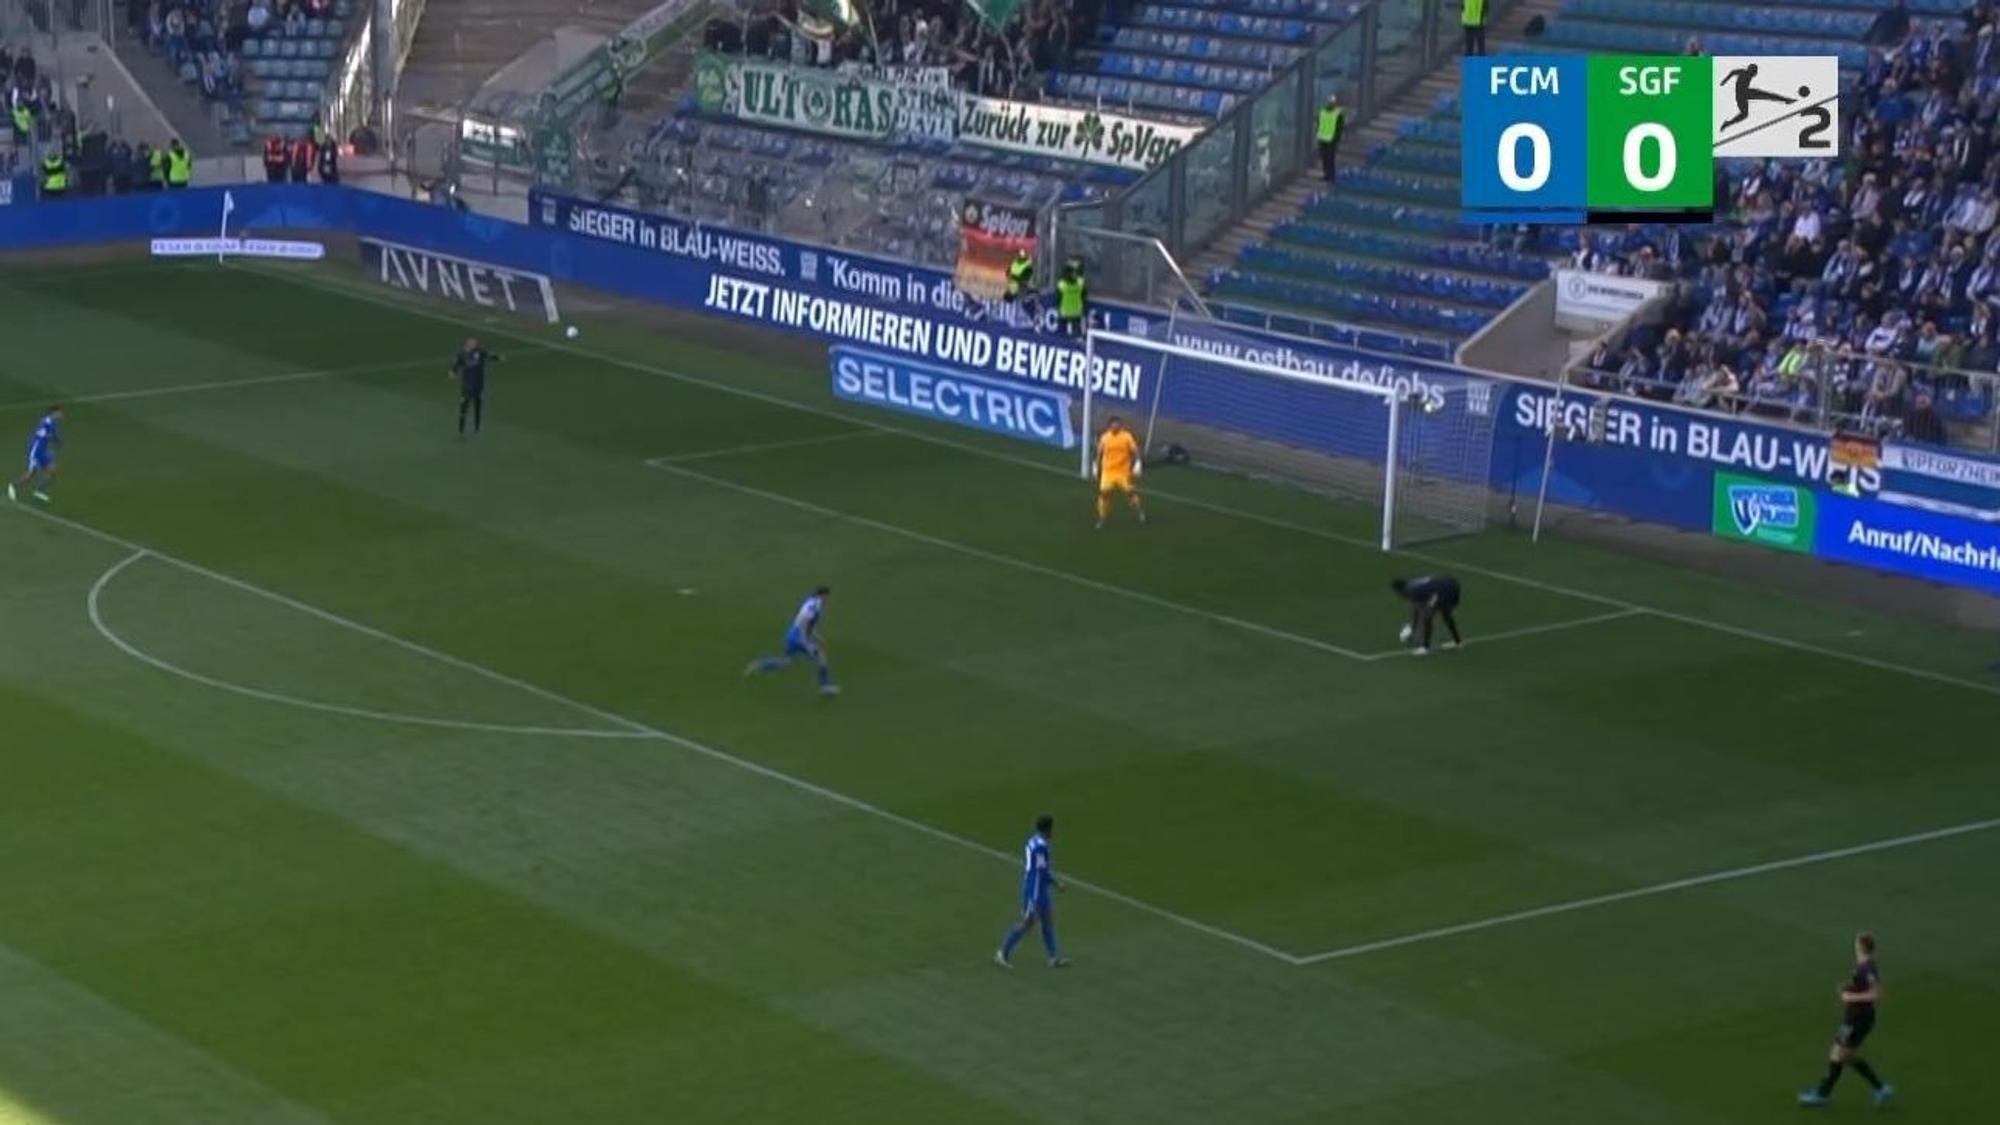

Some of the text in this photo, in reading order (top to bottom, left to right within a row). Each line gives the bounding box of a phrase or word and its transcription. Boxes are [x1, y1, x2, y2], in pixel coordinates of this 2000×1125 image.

[962, 99, 1182, 170] Zurück zur SpVgg
[569, 205, 636, 244] SIEGER
[640, 221, 656, 249] in
[660, 222, 786, 276] BLAU-WEISS.
[906, 274, 927, 303] in
[932, 278, 964, 310] die
[704, 274, 770, 313] JETZT
[773, 288, 932, 355] INFORMIEREN
[935, 324, 992, 367] UND
[996, 338, 1141, 401] BEWERBEN
[837, 356, 1057, 438] SELECTRIC
[1650, 416, 1678, 454] in
[1847, 518, 2000, 572] Anruf/Nachri
